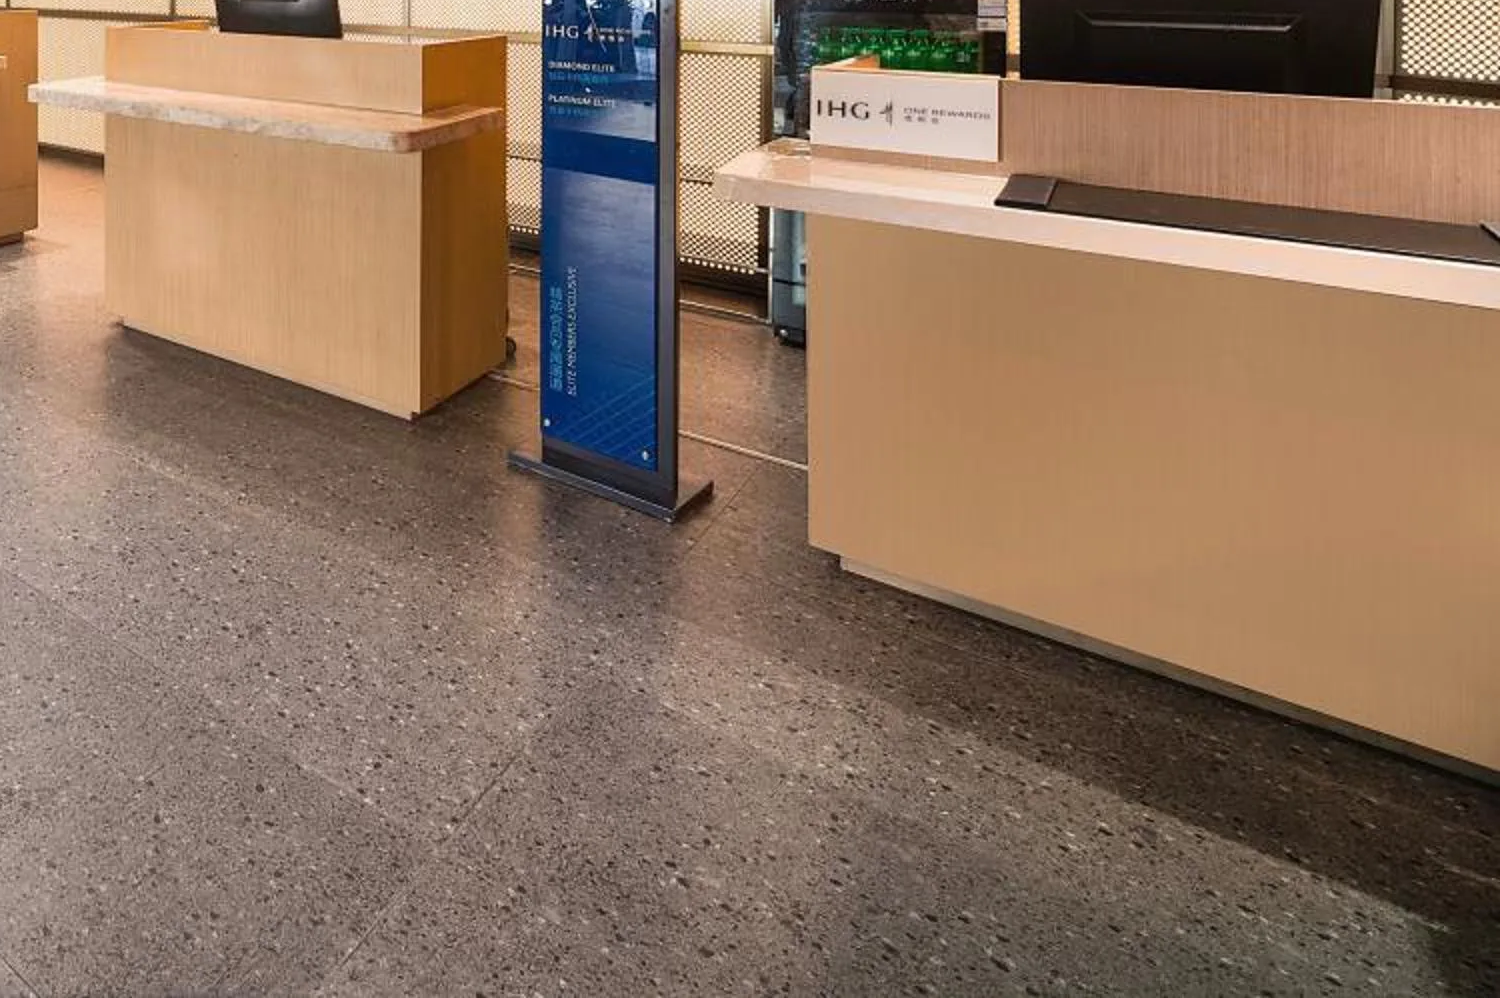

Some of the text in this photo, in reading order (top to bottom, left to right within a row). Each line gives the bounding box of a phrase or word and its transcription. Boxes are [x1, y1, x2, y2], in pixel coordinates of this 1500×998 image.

[545, 25, 579, 39] IHG
[548, 61, 616, 73] DIAMOND ELITE
[548, 94, 616, 108] PLATINUM ELITE
[816, 99, 870, 120] IHG
[903, 107, 991, 119] ONE REWARDS
